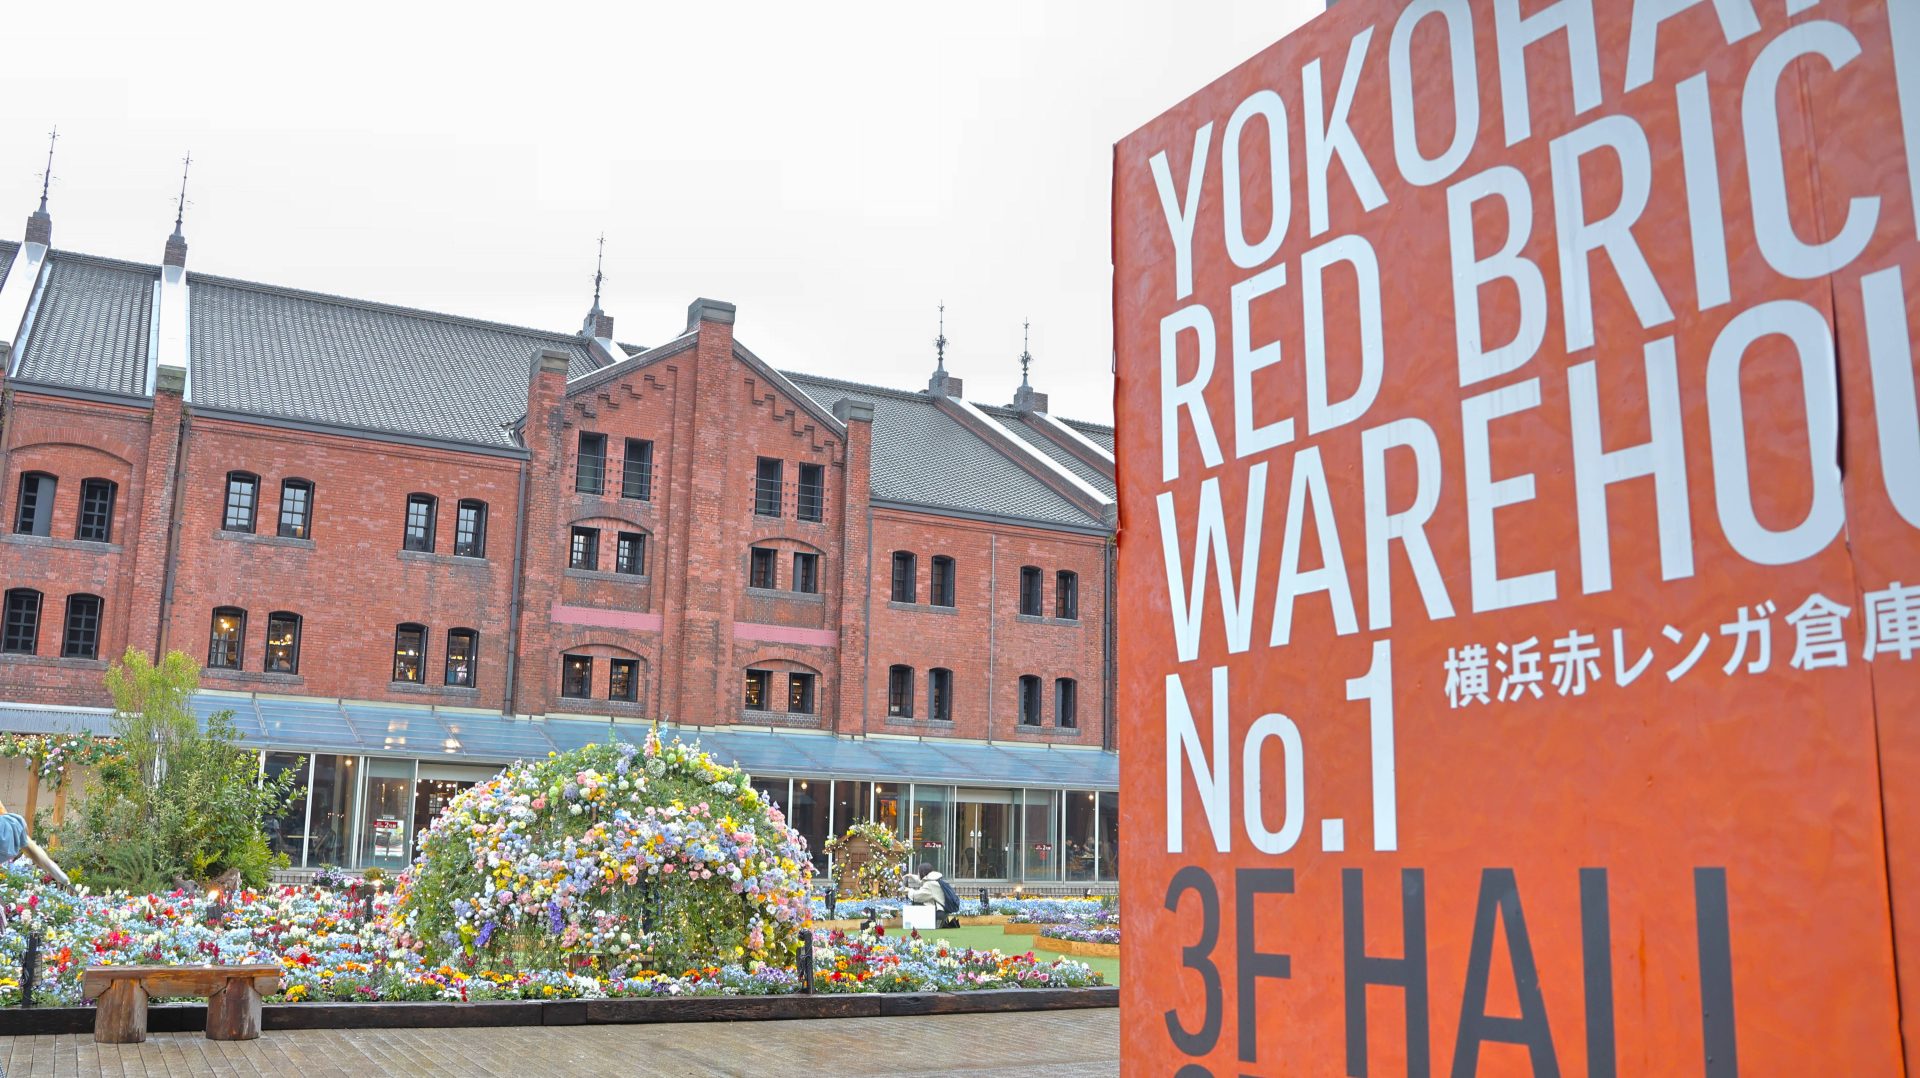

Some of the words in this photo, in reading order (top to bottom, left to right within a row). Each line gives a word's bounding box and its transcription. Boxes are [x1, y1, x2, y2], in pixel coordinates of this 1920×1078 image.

[1149, 0, 1820, 300] YOKOH
[1160, 234, 1384, 482] RED
[1446, 0, 1920, 388] BRIC
[1166, 639, 1397, 854] No.1
[1444, 581, 1920, 708] 横浜赤レンガ倉庫
[1164, 866, 1294, 1062] 3F
